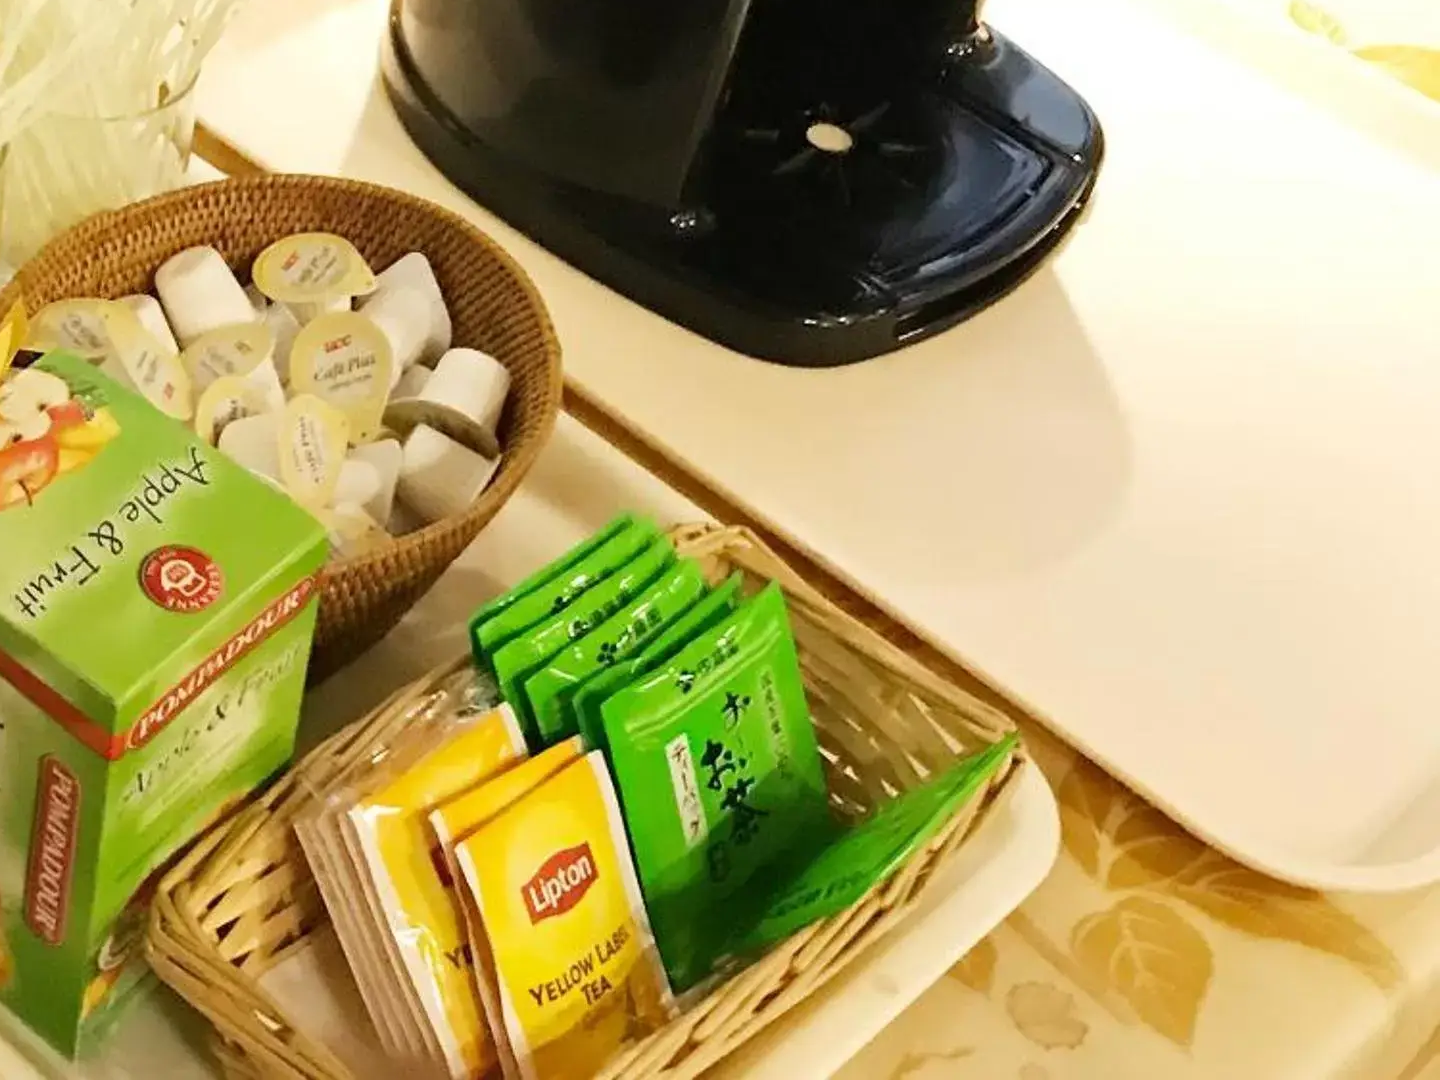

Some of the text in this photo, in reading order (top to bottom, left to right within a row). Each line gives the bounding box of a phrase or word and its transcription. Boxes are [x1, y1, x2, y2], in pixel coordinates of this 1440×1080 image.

[119, 446, 209, 524] Apple
[87, 520, 124, 555] &
[15, 545, 101, 618] Fruit
[34, 764, 73, 934] POMPADOUR
[527, 855, 592, 913] Lipton
[528, 952, 595, 1007] YELLOW
[580, 974, 612, 1006] TEA
